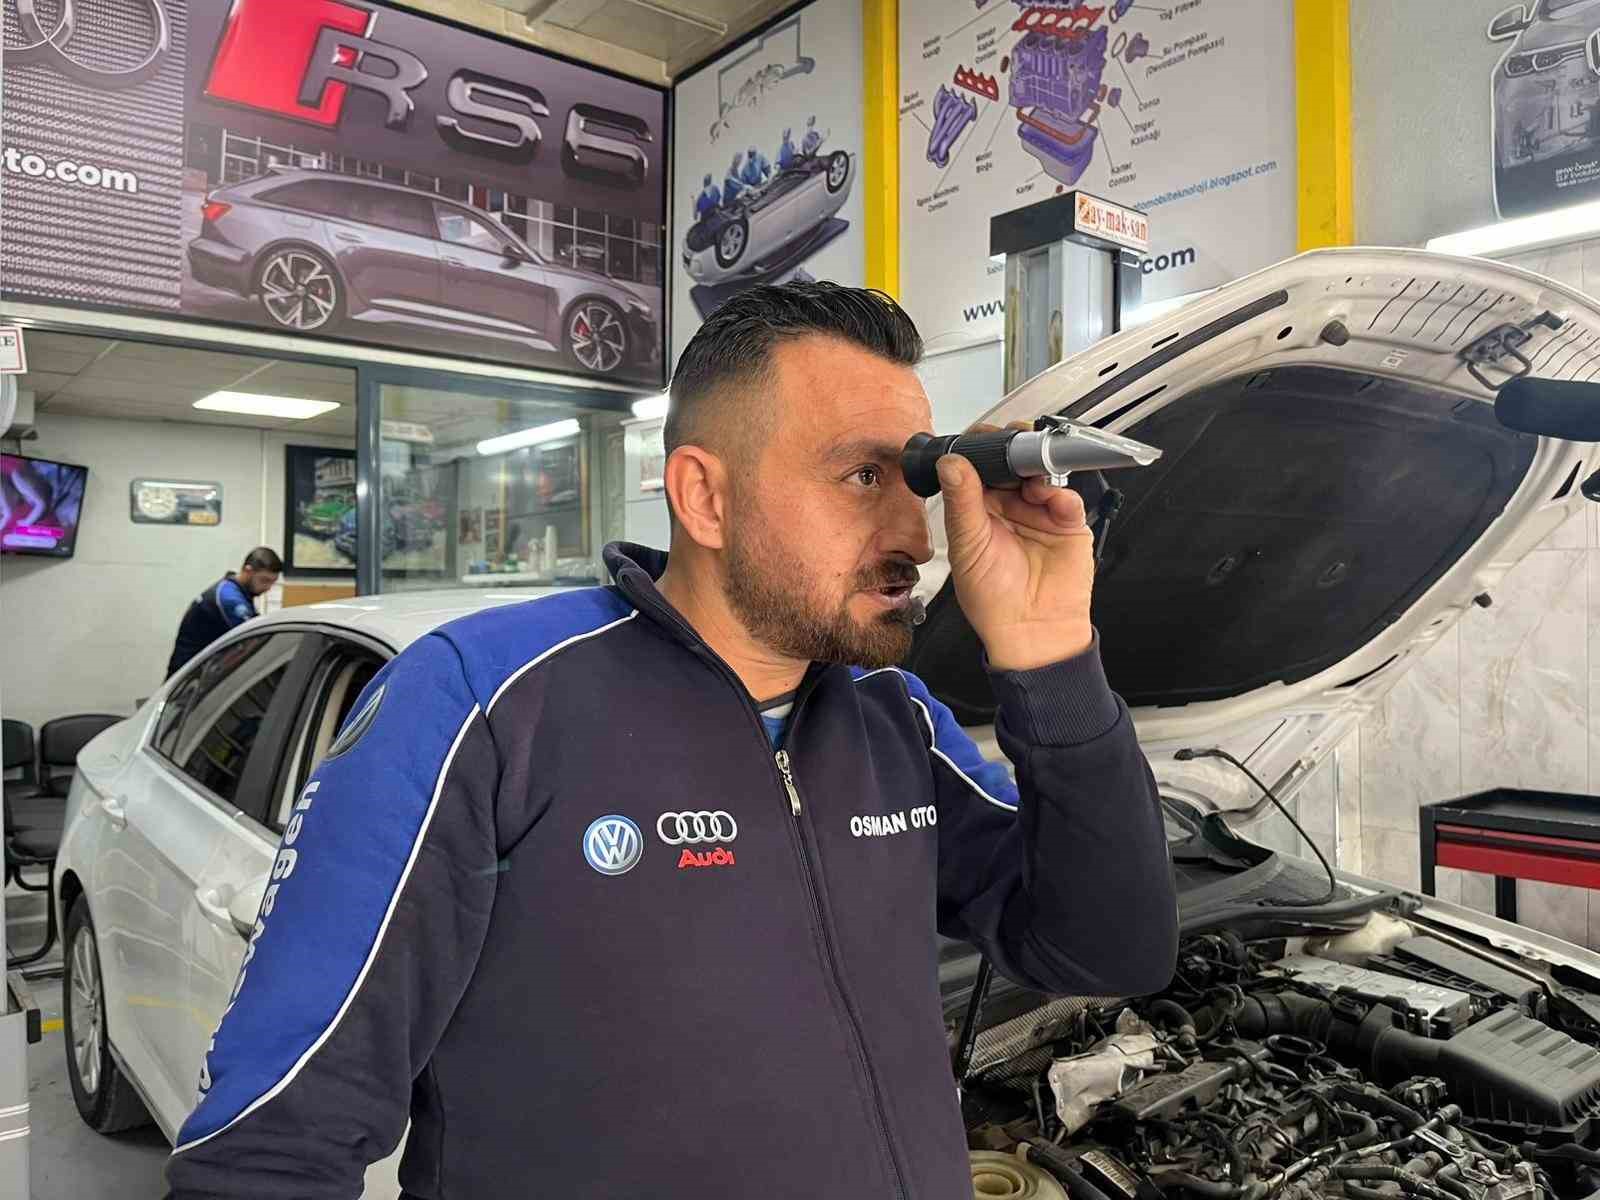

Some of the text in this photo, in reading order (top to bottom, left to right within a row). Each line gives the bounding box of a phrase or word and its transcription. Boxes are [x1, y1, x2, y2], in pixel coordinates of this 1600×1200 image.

[0, 146, 138, 193] to.com
[850, 804, 937, 838] OSMAN OTO
[679, 848, 734, 868] Audi
